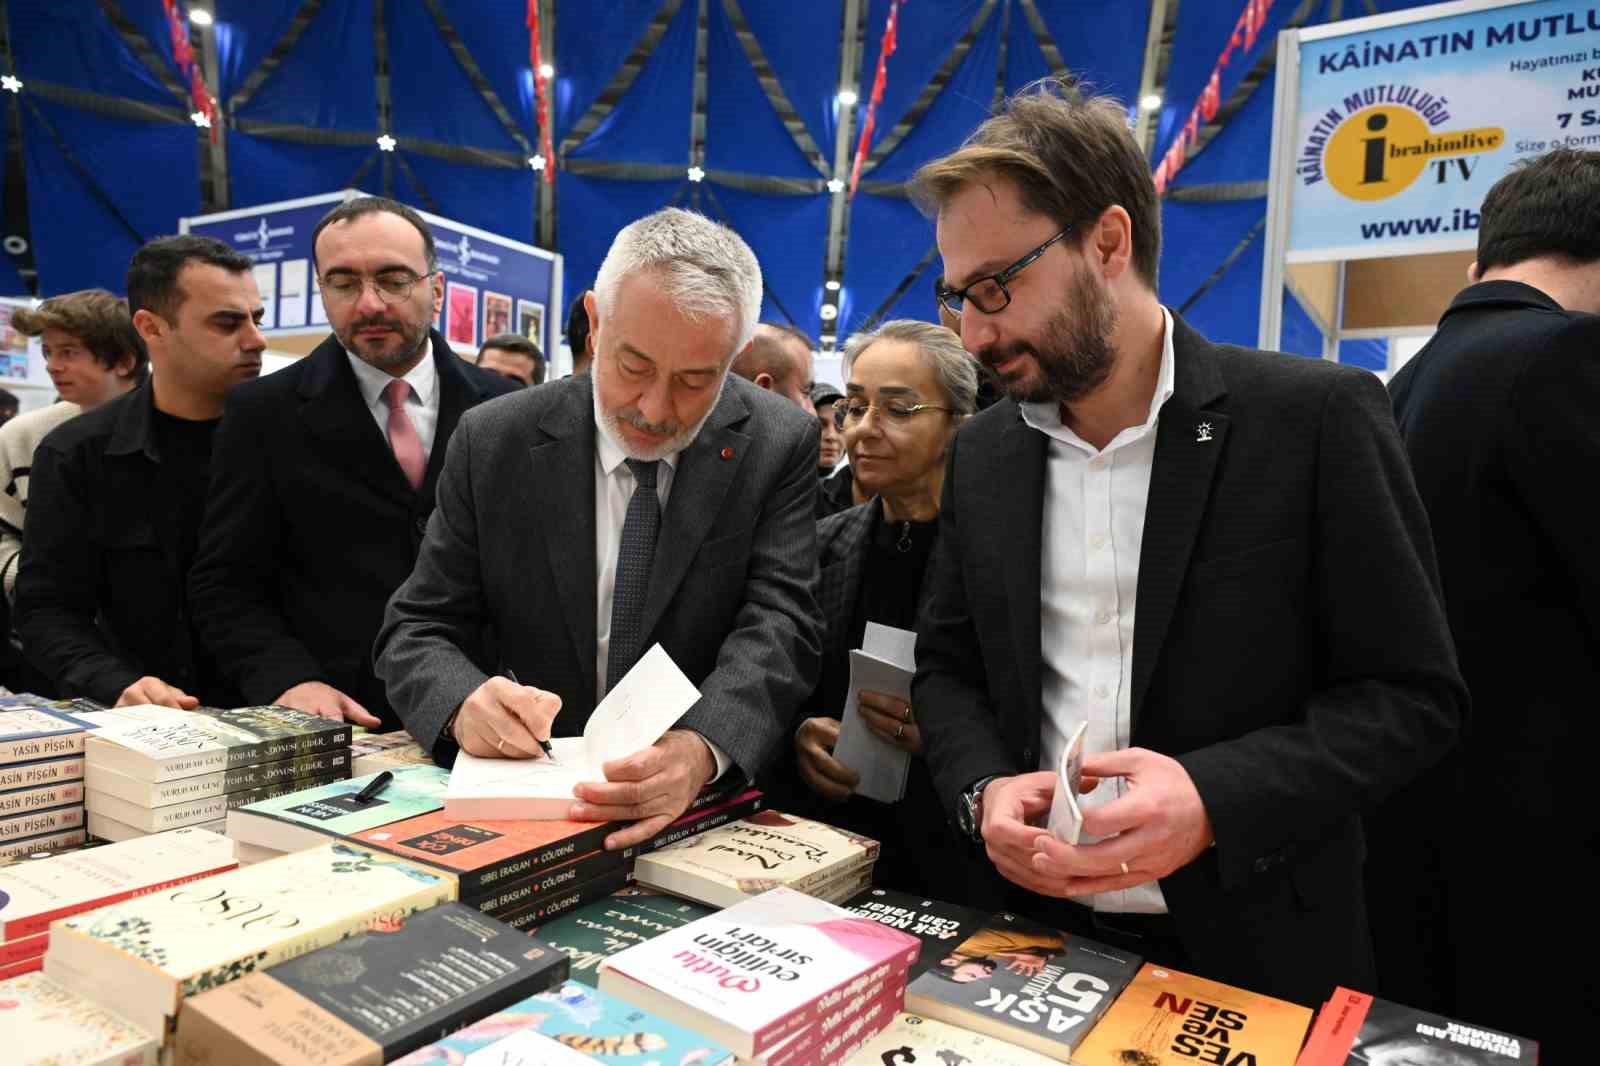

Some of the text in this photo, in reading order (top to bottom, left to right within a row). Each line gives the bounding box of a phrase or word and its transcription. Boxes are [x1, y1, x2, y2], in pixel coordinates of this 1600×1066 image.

[1557, 112, 1573, 129] 7
[1430, 155, 1480, 185] TV
[974, 987, 1085, 1034] AŞK
[1047, 972, 1110, 1014] 5
[1153, 991, 1248, 1031] SEN
[1181, 1019, 1230, 1044] ve
